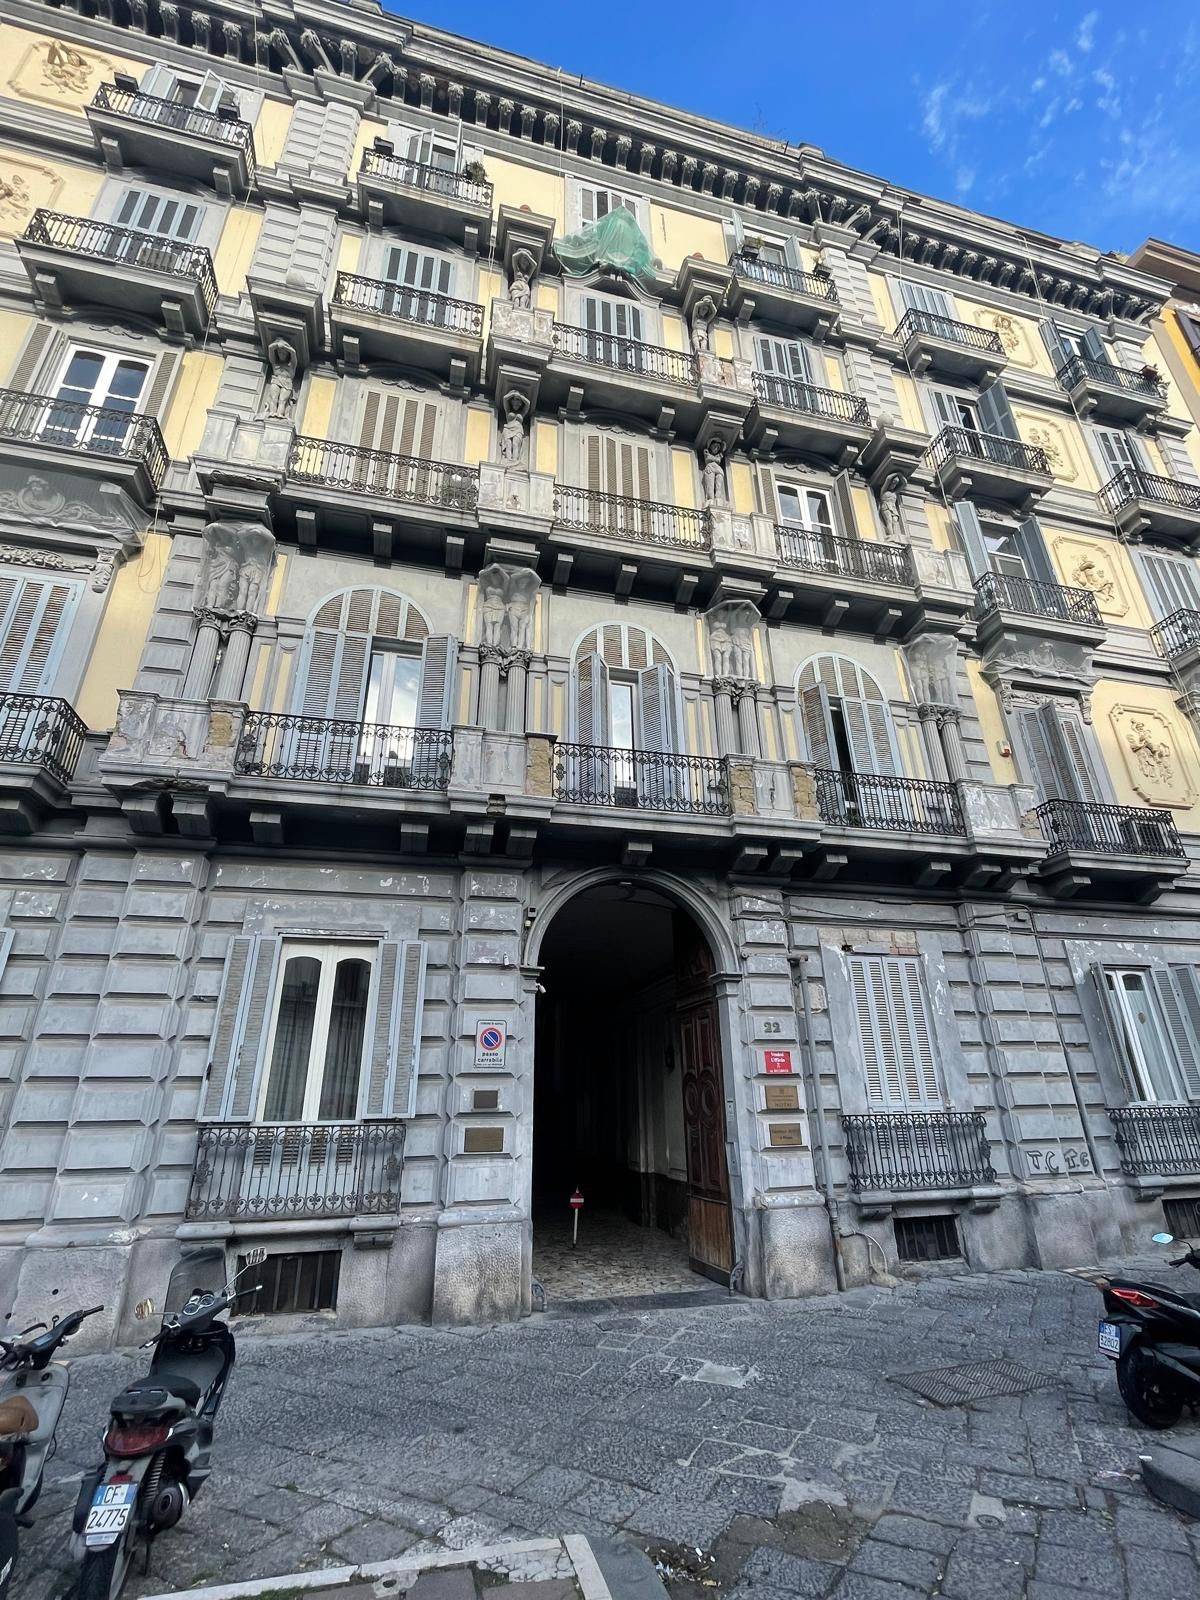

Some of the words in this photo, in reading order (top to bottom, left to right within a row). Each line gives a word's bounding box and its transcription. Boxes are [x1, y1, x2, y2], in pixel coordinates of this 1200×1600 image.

[763, 1021, 781, 1033] 22
[103, 1485, 122, 1504] CF
[86, 1508, 129, 1530] 24775
